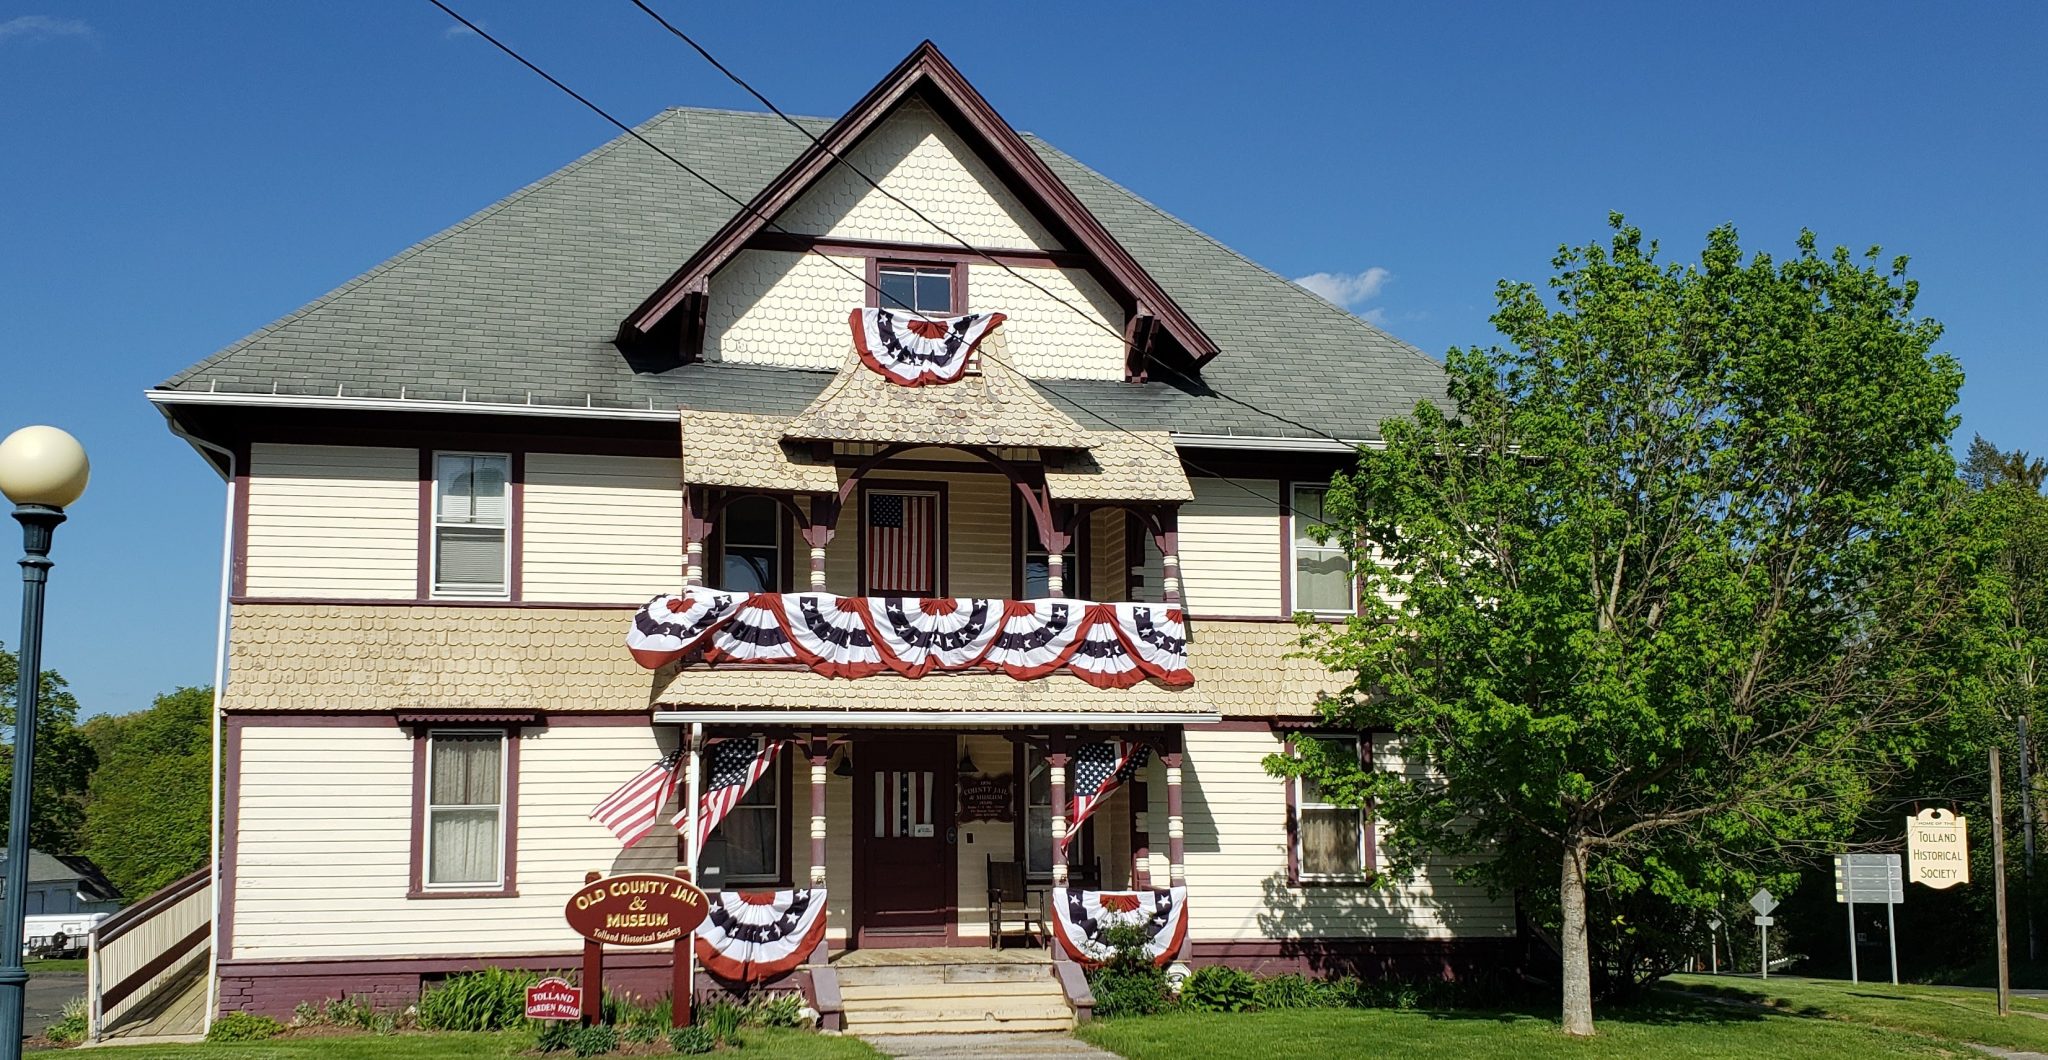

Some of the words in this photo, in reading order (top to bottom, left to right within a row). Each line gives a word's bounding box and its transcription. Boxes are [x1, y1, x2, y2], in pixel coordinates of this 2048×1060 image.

[964, 786, 992, 795] COUNTY
[993, 786, 1008, 795] JAIL
[1918, 831, 1957, 843] TOLLAND
[1913, 849, 1963, 861] HISTORICAL
[1920, 866, 1957, 879] SOCIETY
[576, 888, 606, 910] OLD
[610, 880, 670, 897] COUNTY
[670, 884, 700, 907] JAIL
[628, 896, 648, 911] &
[606, 913, 669, 928] MUSEUM
[593, 928, 619, 942] Tolland
[620, 931, 655, 943] Historical
[656, 926, 682, 940] Society
[532, 992, 574, 1003] TOLLAND
[528, 1003, 556, 1014] GARDEN
[558, 1004, 579, 1017] PATHS
